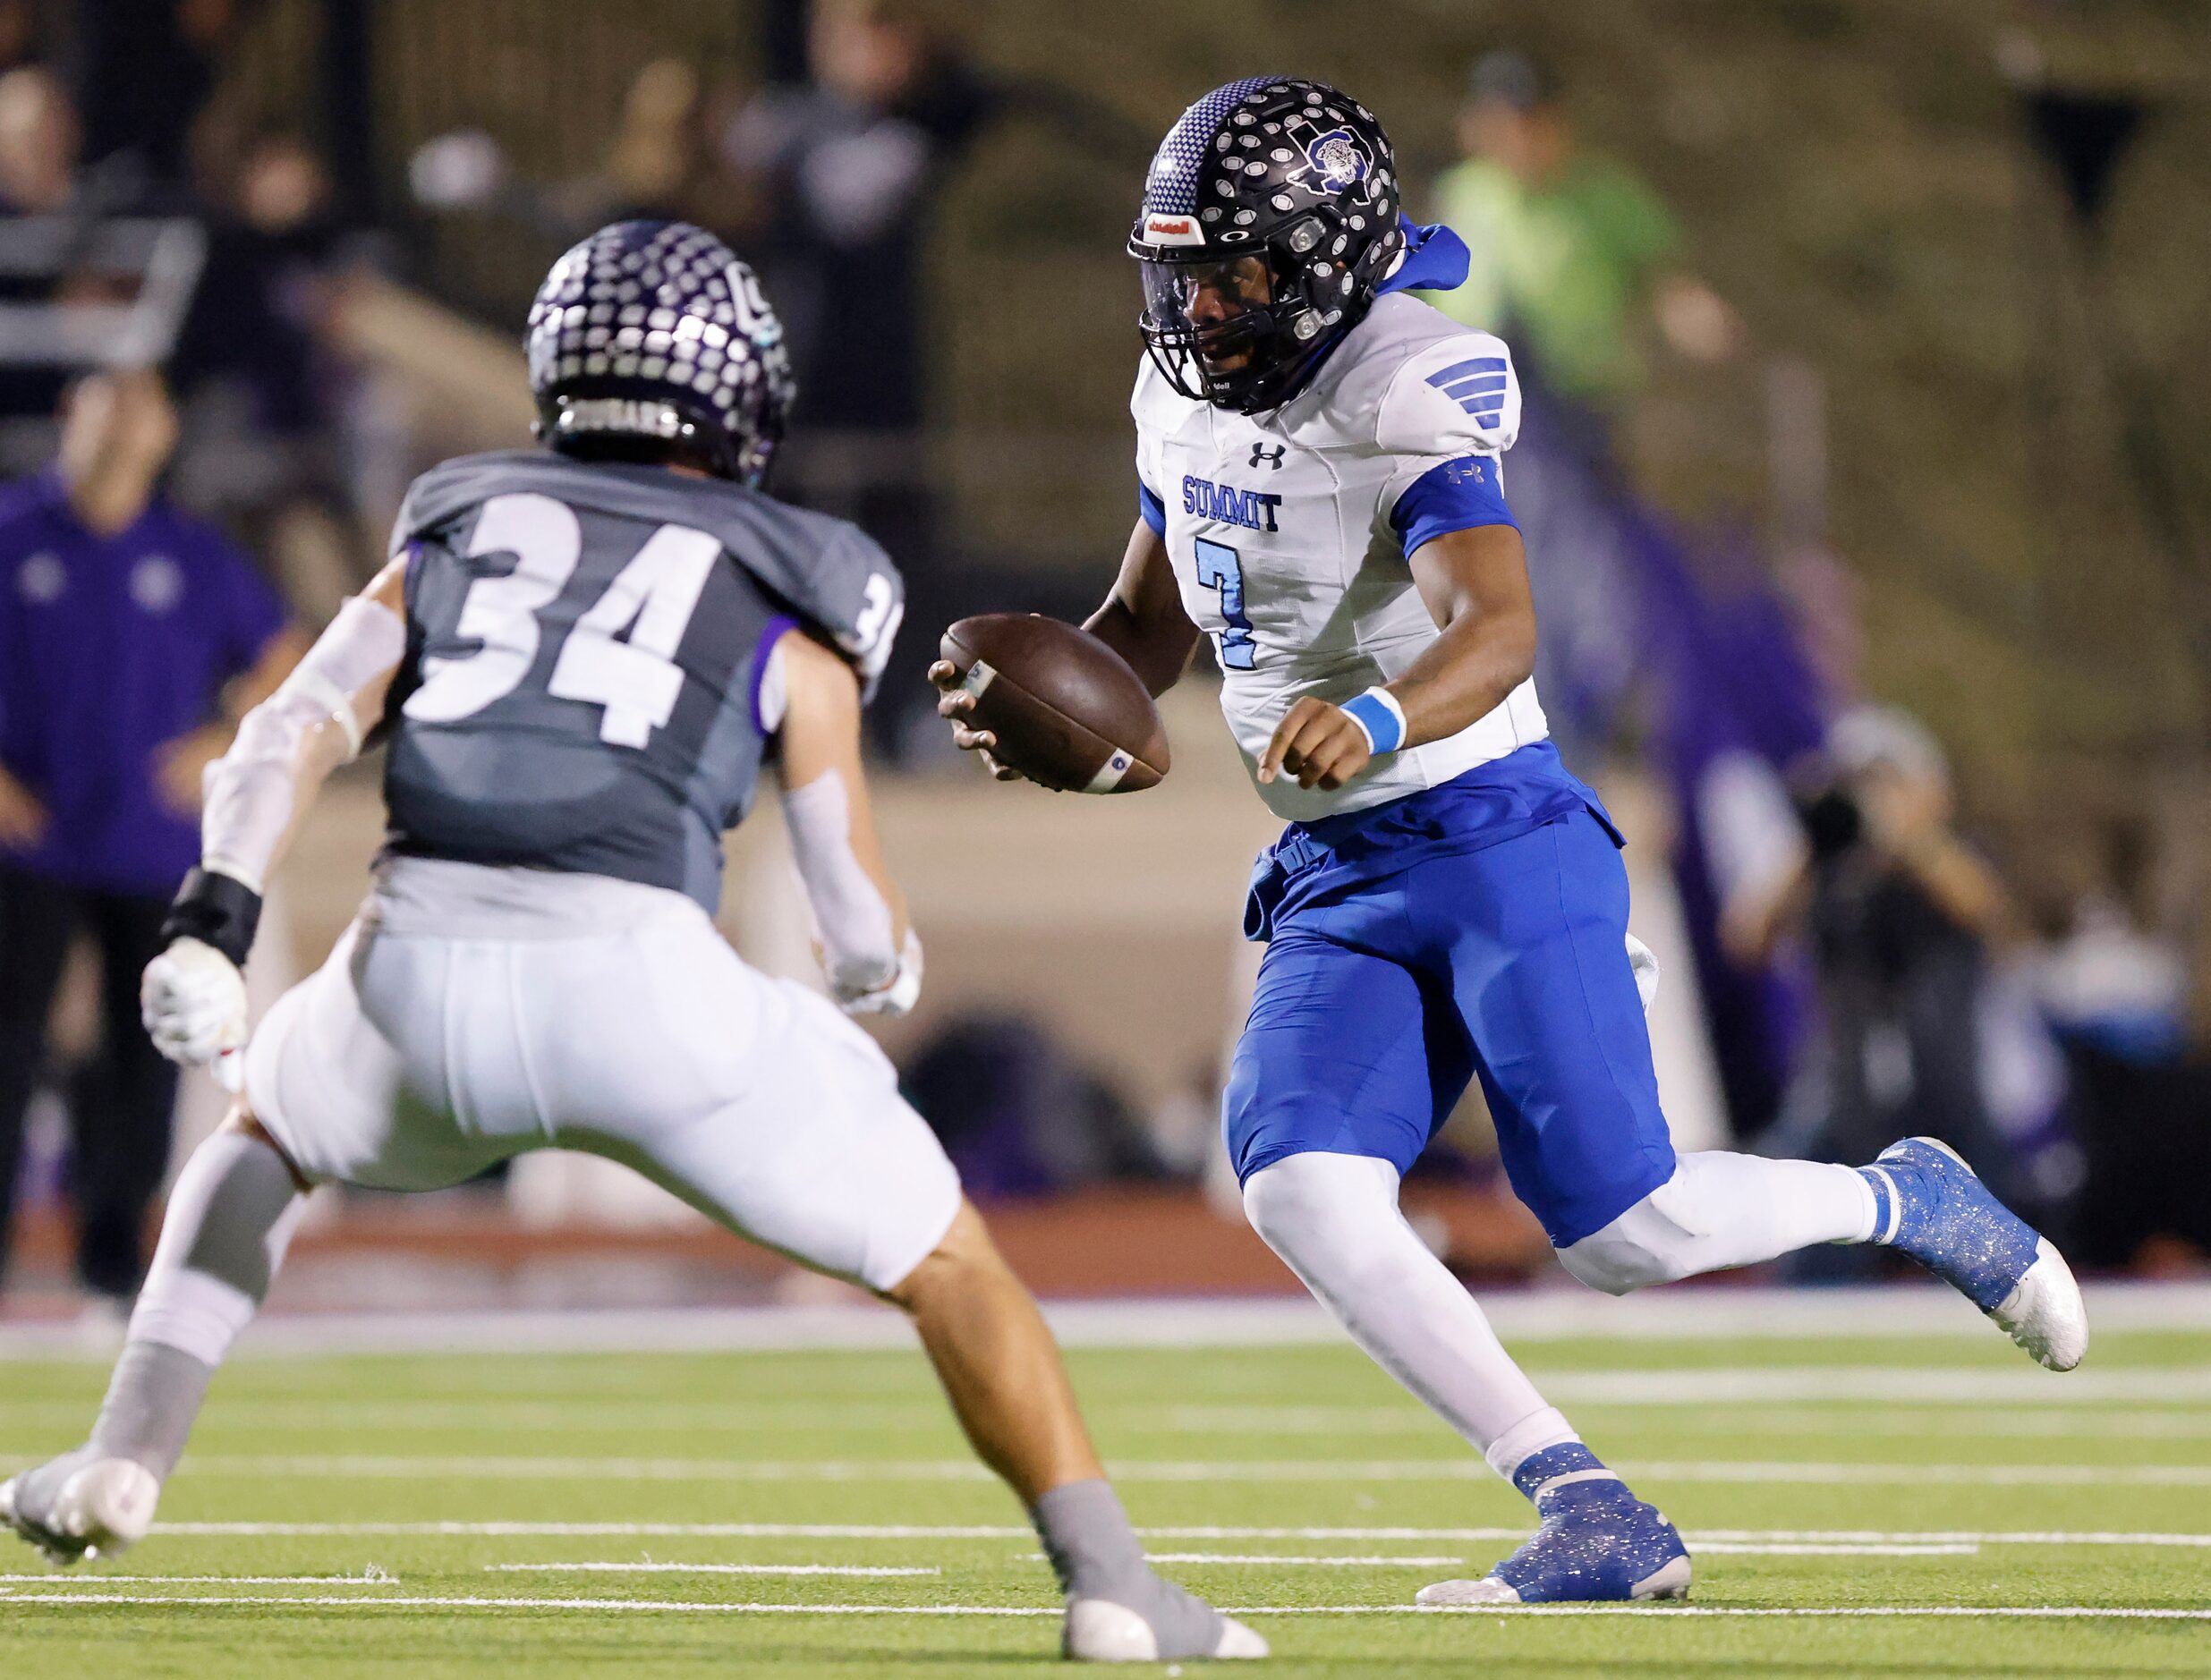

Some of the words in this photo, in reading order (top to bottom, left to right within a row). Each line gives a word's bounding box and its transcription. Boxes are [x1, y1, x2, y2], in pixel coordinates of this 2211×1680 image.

[1182, 475, 1281, 532] SUMMIT
[403, 493, 721, 749] 34
[1195, 537, 1257, 670] 7
